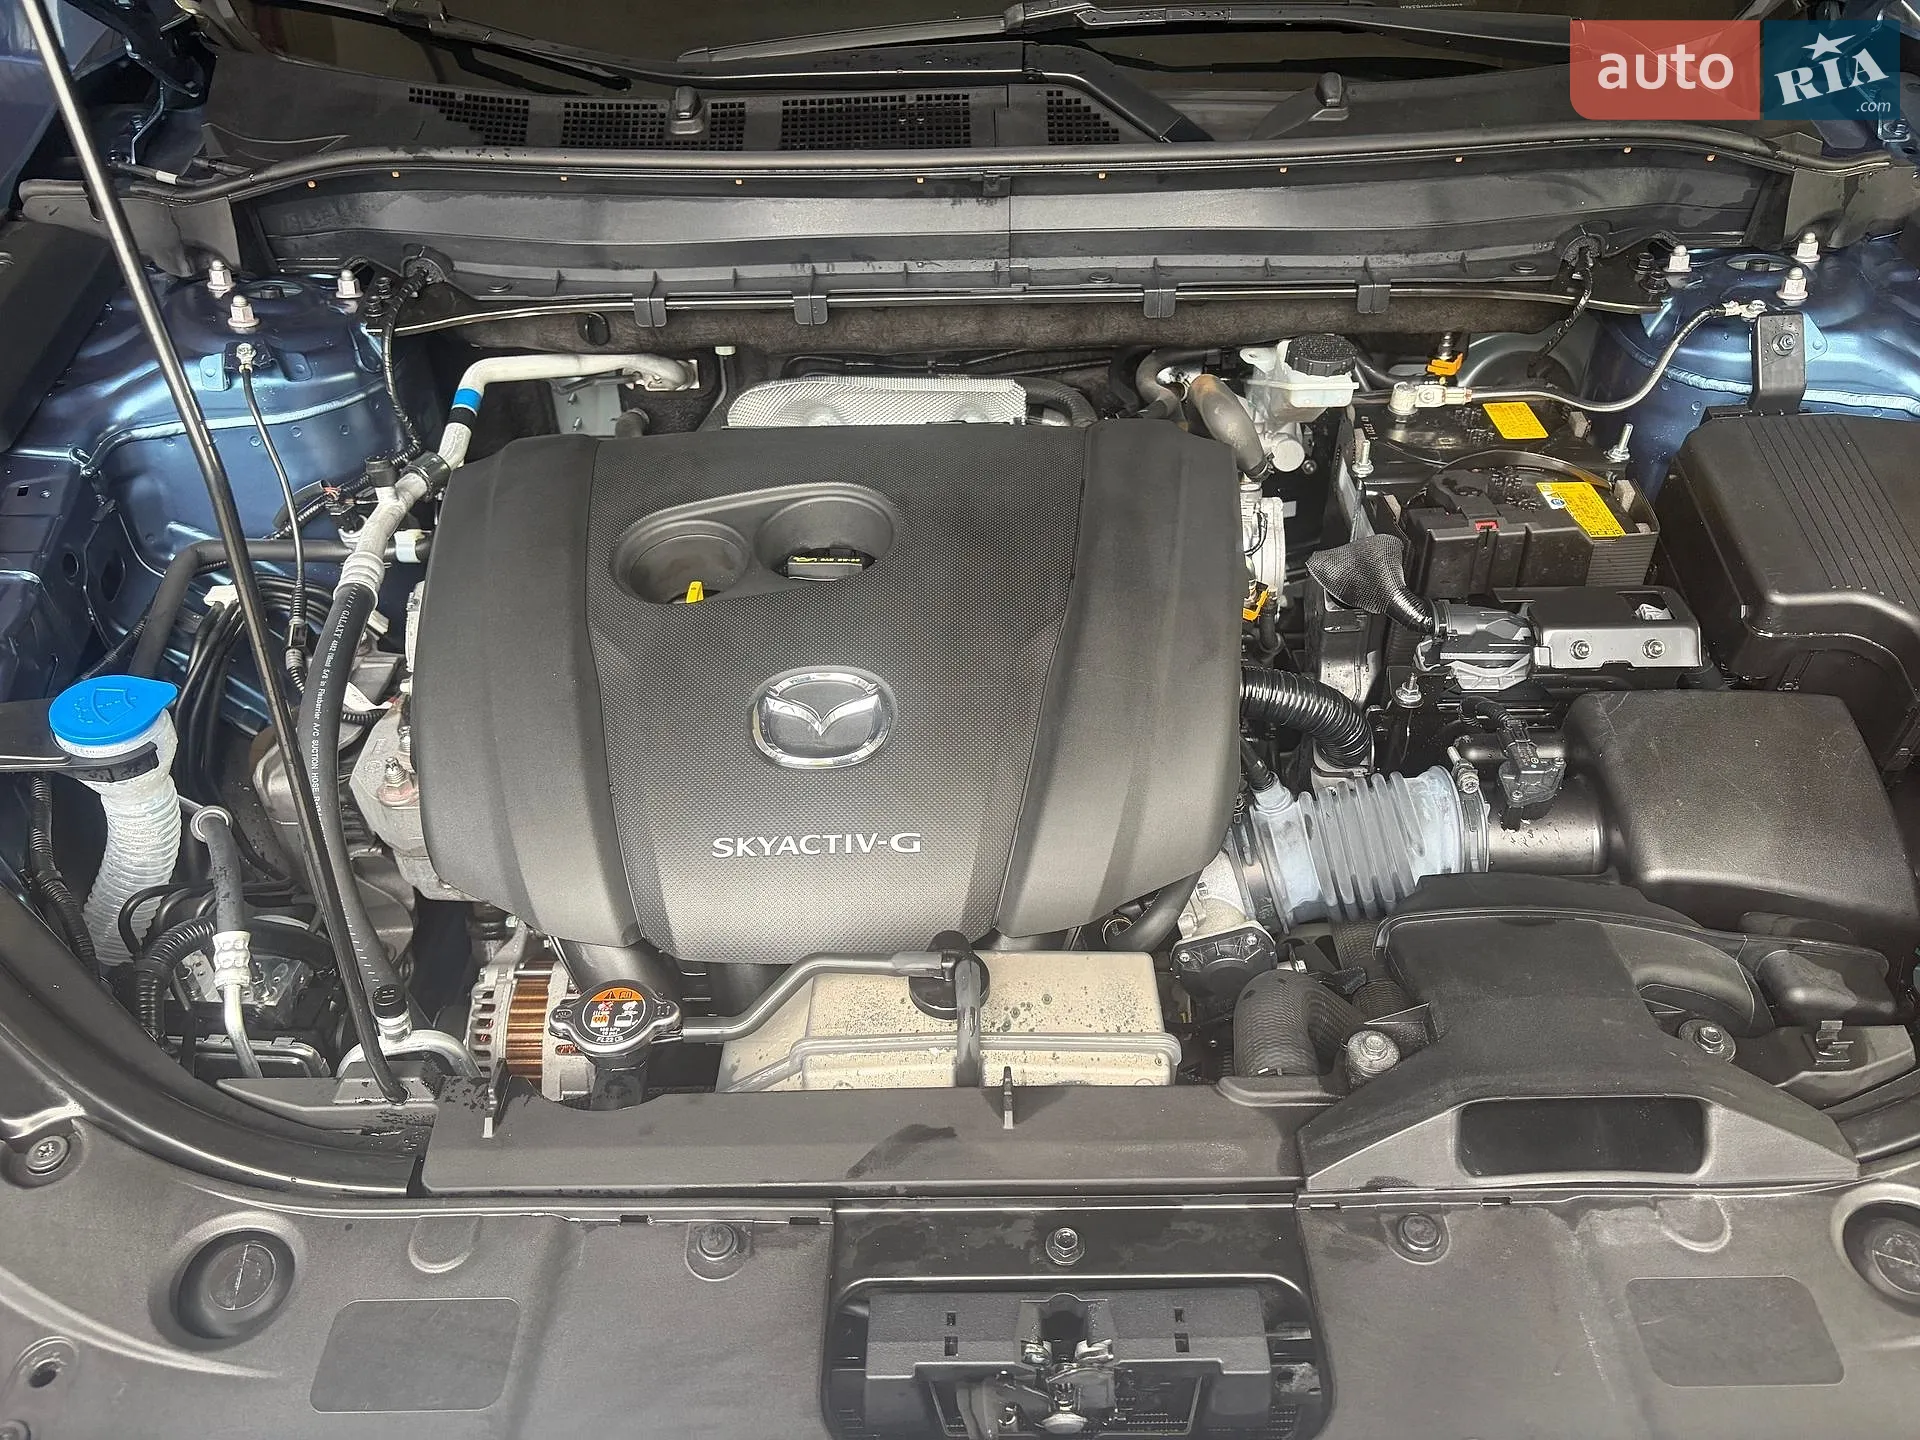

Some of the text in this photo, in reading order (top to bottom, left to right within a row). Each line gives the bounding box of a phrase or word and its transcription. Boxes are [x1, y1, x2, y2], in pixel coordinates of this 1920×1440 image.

[334, 610, 350, 638] GALAXY
[312, 722, 321, 737] A/C
[311, 739, 319, 769] SUCTION
[311, 772, 320, 793] HOSE
[711, 832, 921, 858] SKYACTIV-G
